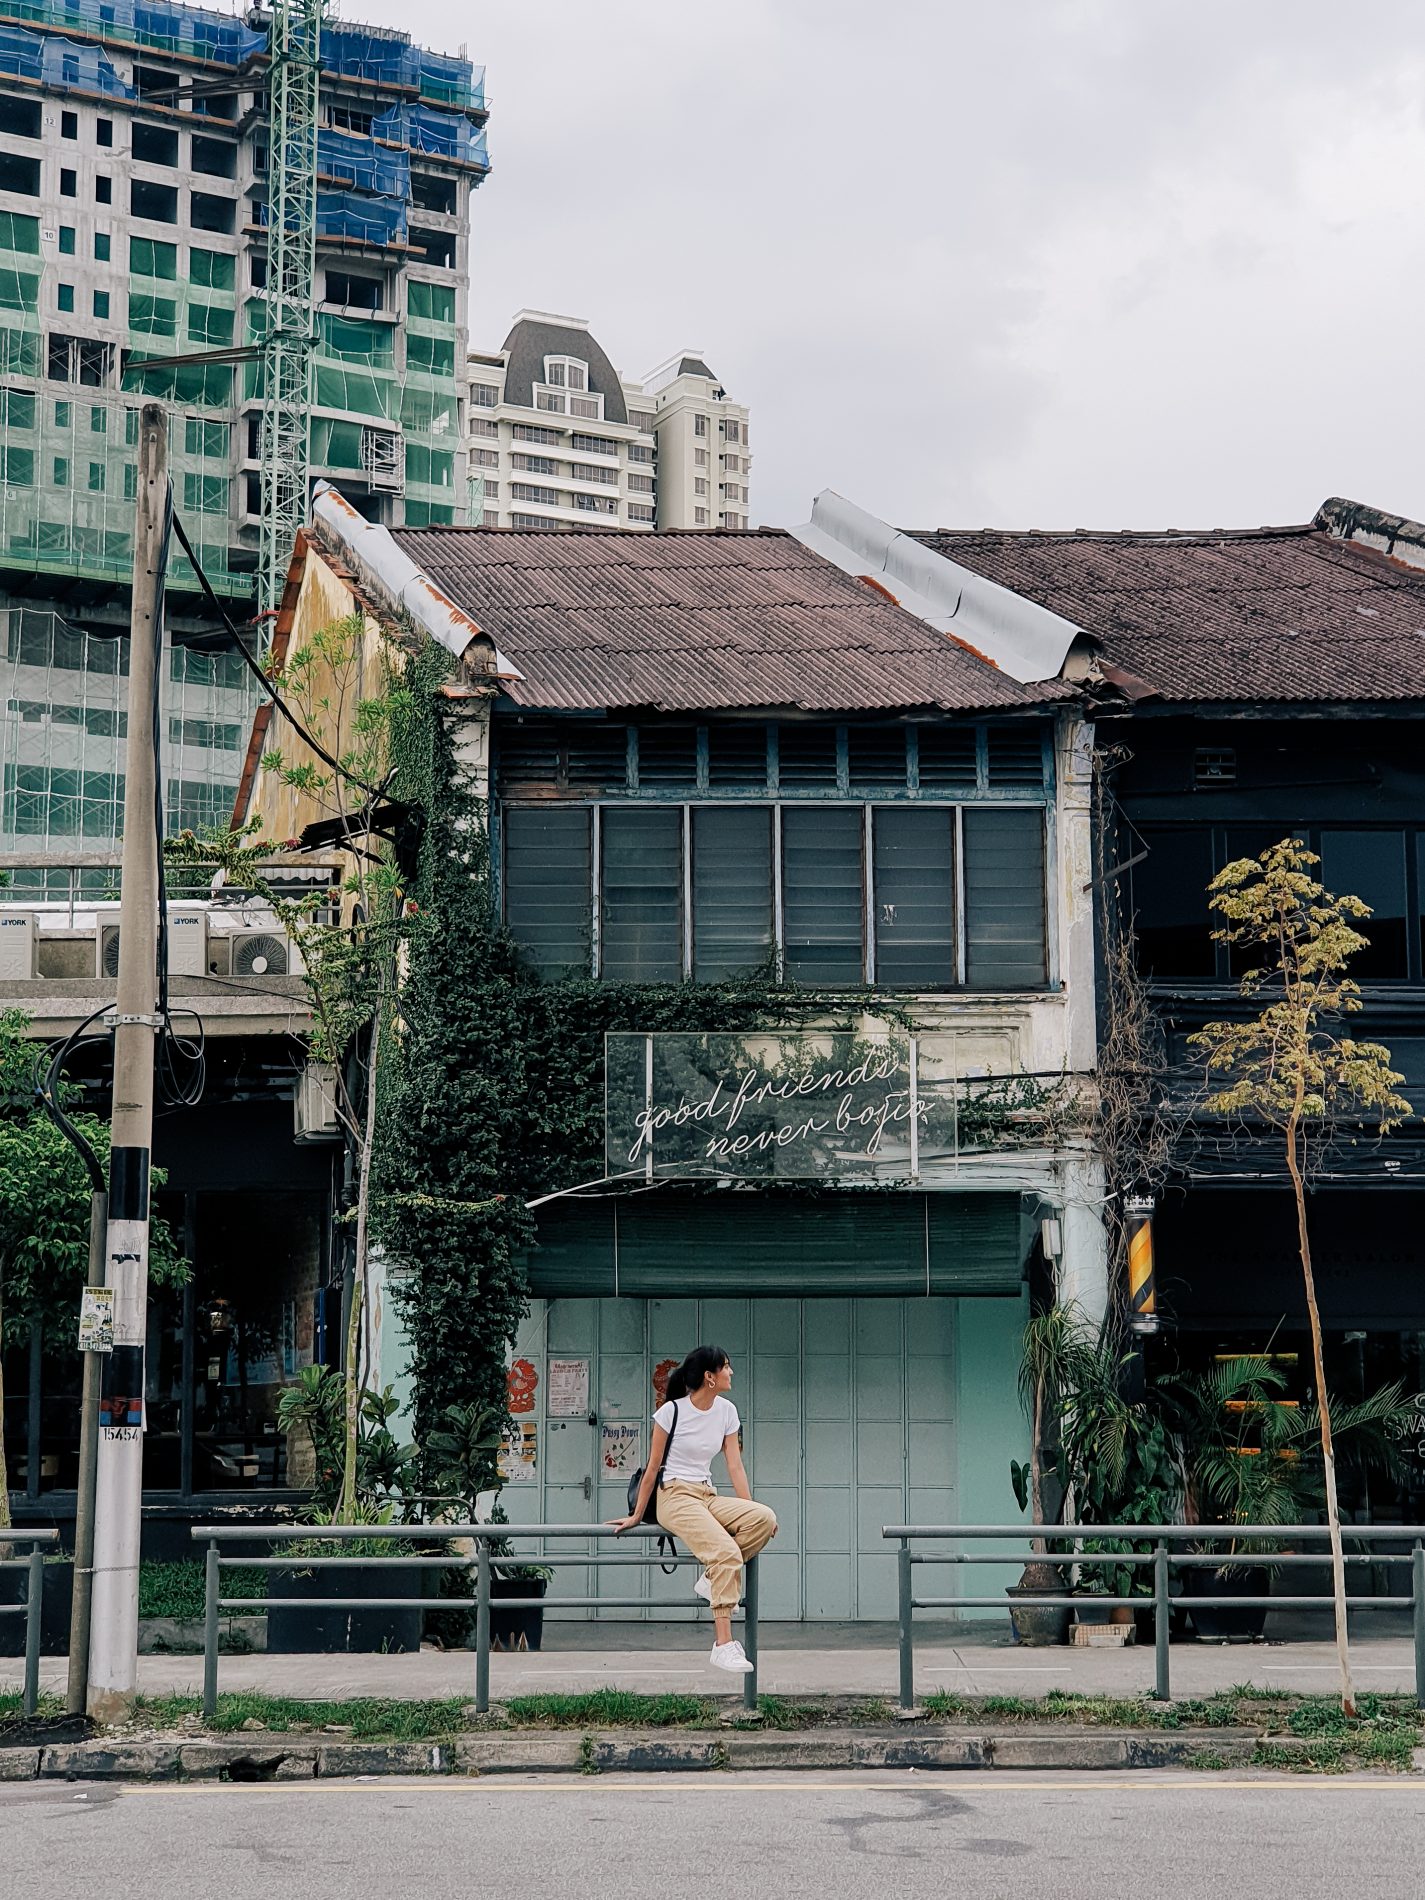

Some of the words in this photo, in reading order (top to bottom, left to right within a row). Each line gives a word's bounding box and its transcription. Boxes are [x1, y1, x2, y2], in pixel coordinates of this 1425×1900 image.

[45, 117, 55, 126] 12
[44, 231, 54, 239] 10
[8, 919, 27, 927] YORK
[180, 917, 200, 925] YORK
[628, 1080, 729, 1163] good
[725, 1045, 900, 1131] friends
[706, 1117, 830, 1158] never
[104, 1427, 139, 1441] 15454
[602, 1426, 620, 1440] Pussy
[621, 1425, 639, 1438] Power
